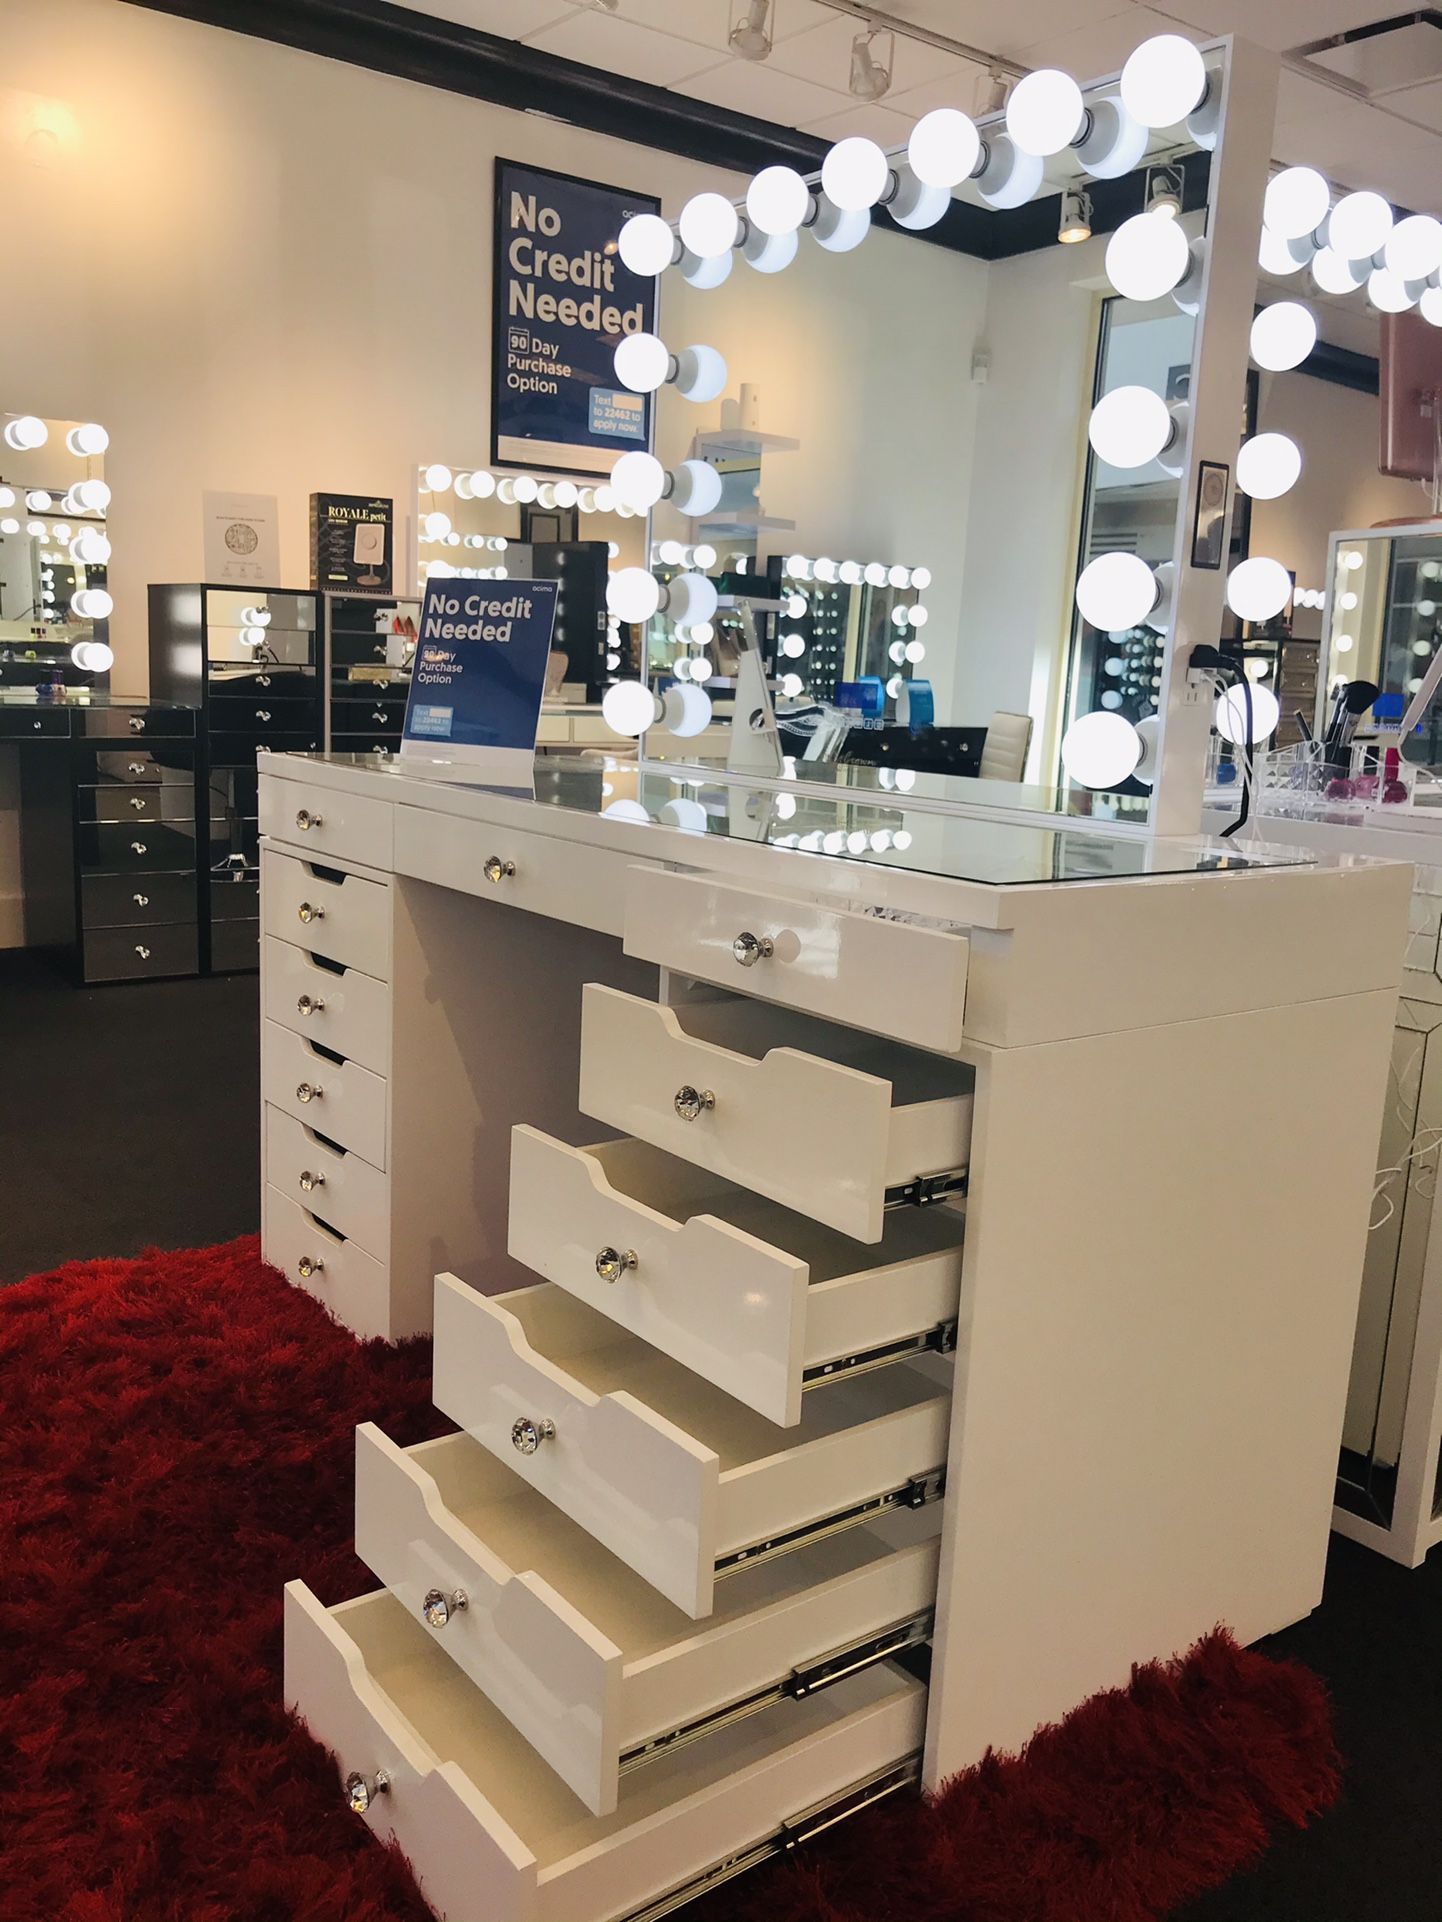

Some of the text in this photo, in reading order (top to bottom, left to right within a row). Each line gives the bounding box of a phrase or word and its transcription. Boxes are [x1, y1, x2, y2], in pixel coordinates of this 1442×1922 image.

[510, 191, 562, 237] No
[508, 237, 615, 293] Credit
[508, 279, 644, 335] Needed
[510, 335, 559, 360] 90 Day
[507, 353, 572, 378] Purchase
[507, 373, 558, 394] Option
[594, 394, 611, 406] Text
[593, 407, 603, 416] to
[632, 411, 641, 422] to
[593, 419, 617, 431] apply
[328, 505, 369, 521] ROYALE
[532, 585, 553, 593] acima
[428, 594, 533, 619] No Credit
[424, 618, 512, 642] Needed
[438, 649, 457, 662] Day
[419, 661, 463, 673] Purchase
[417, 672, 452, 685] Option
